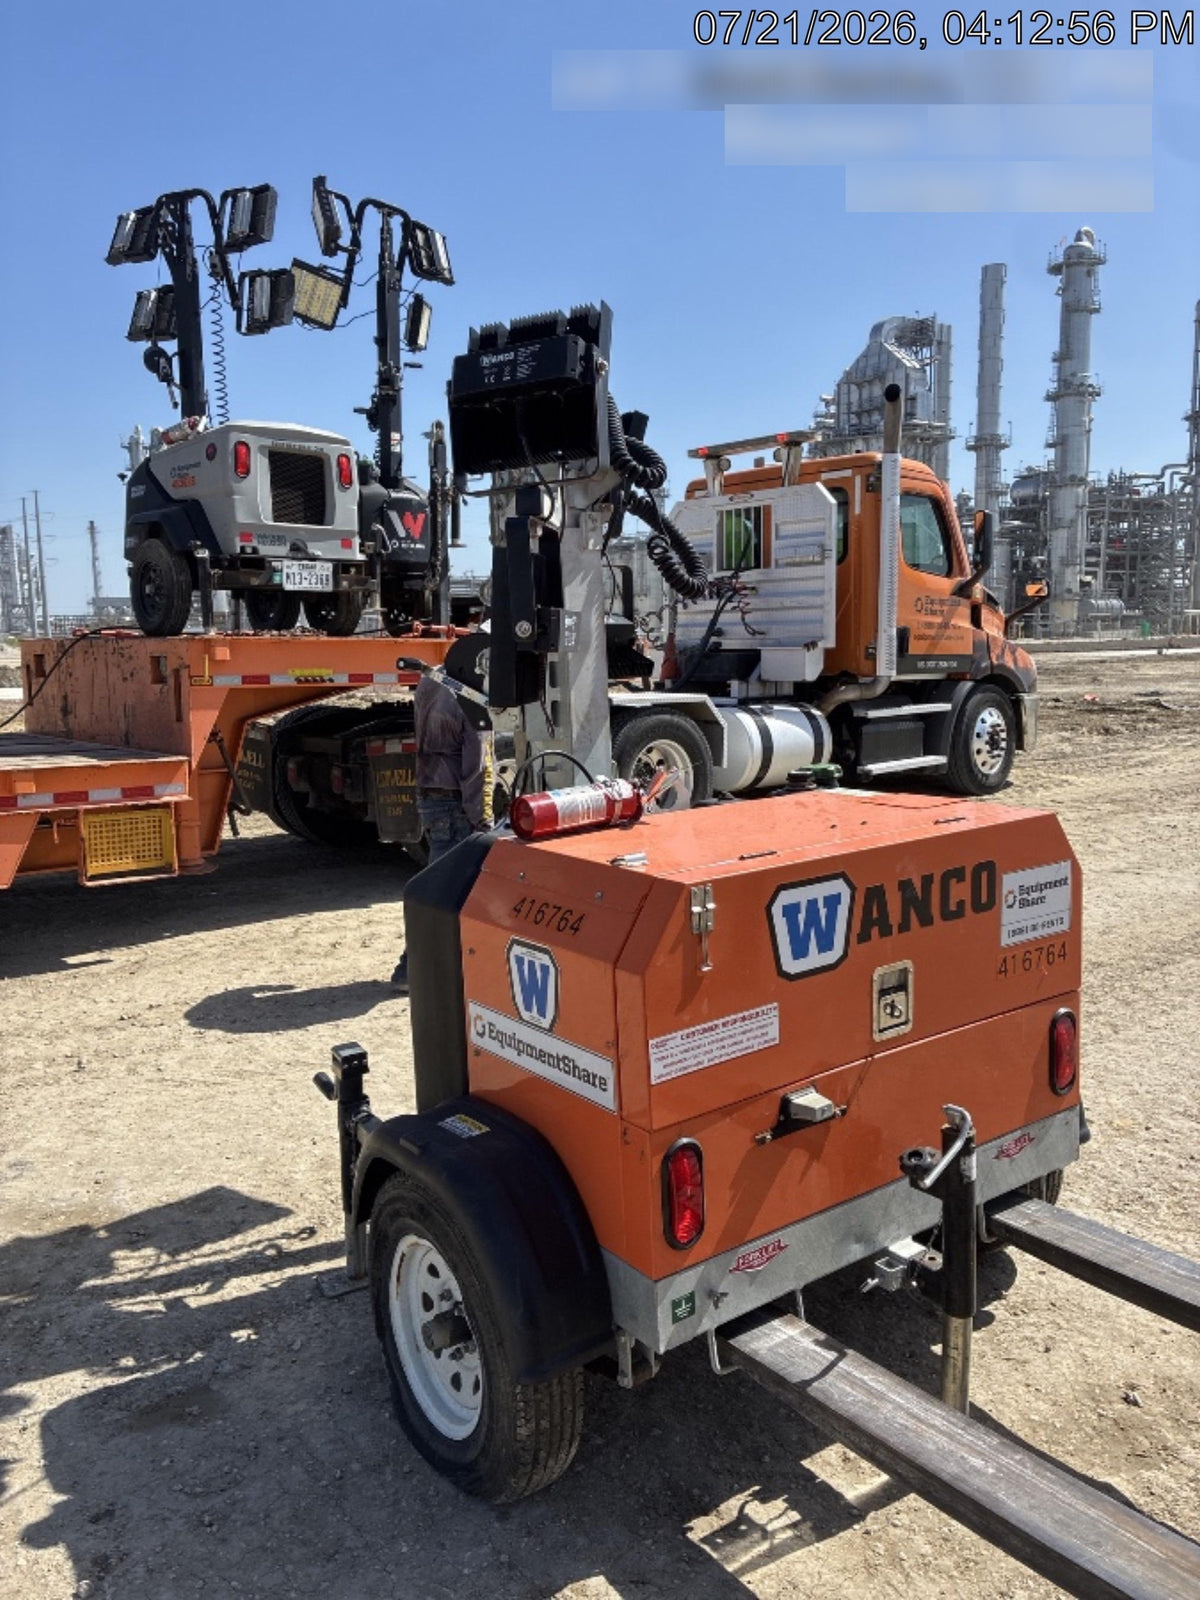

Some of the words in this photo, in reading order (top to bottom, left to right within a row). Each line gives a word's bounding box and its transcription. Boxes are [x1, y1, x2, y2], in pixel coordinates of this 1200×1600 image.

[1018, 876, 1069, 897] Equipment
[1018, 895, 1046, 909] Share
[512, 897, 586, 936] 416764
[778, 860, 998, 964] WANCO
[997, 941, 1067, 977] 416764
[514, 954, 551, 1020] W
[486, 1020, 609, 1093] EquipmentShare
